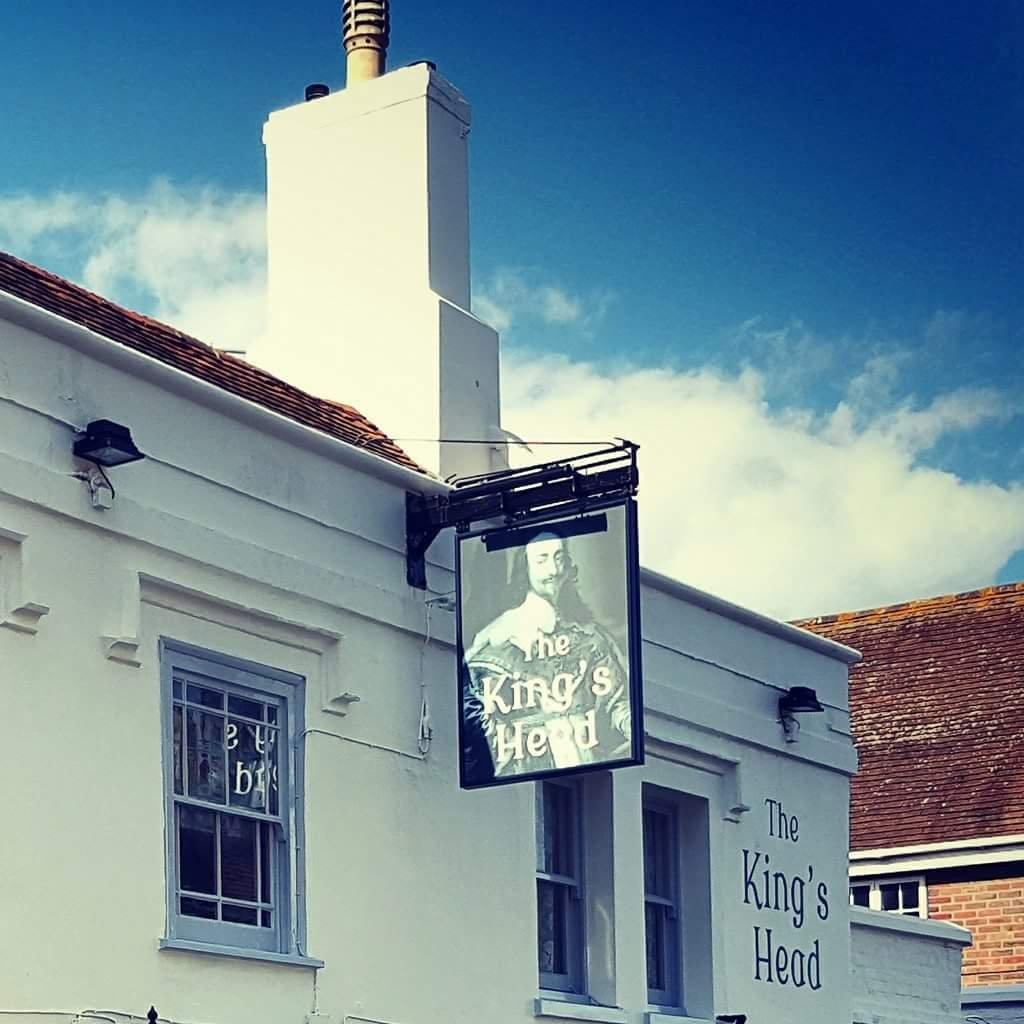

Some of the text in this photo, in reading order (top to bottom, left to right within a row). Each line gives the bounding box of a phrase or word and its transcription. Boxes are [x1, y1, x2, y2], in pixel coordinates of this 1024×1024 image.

[481, 660, 612, 715] King's
[765, 798, 799, 842] The
[742, 849, 829, 928] King's
[753, 926, 822, 990] Head
